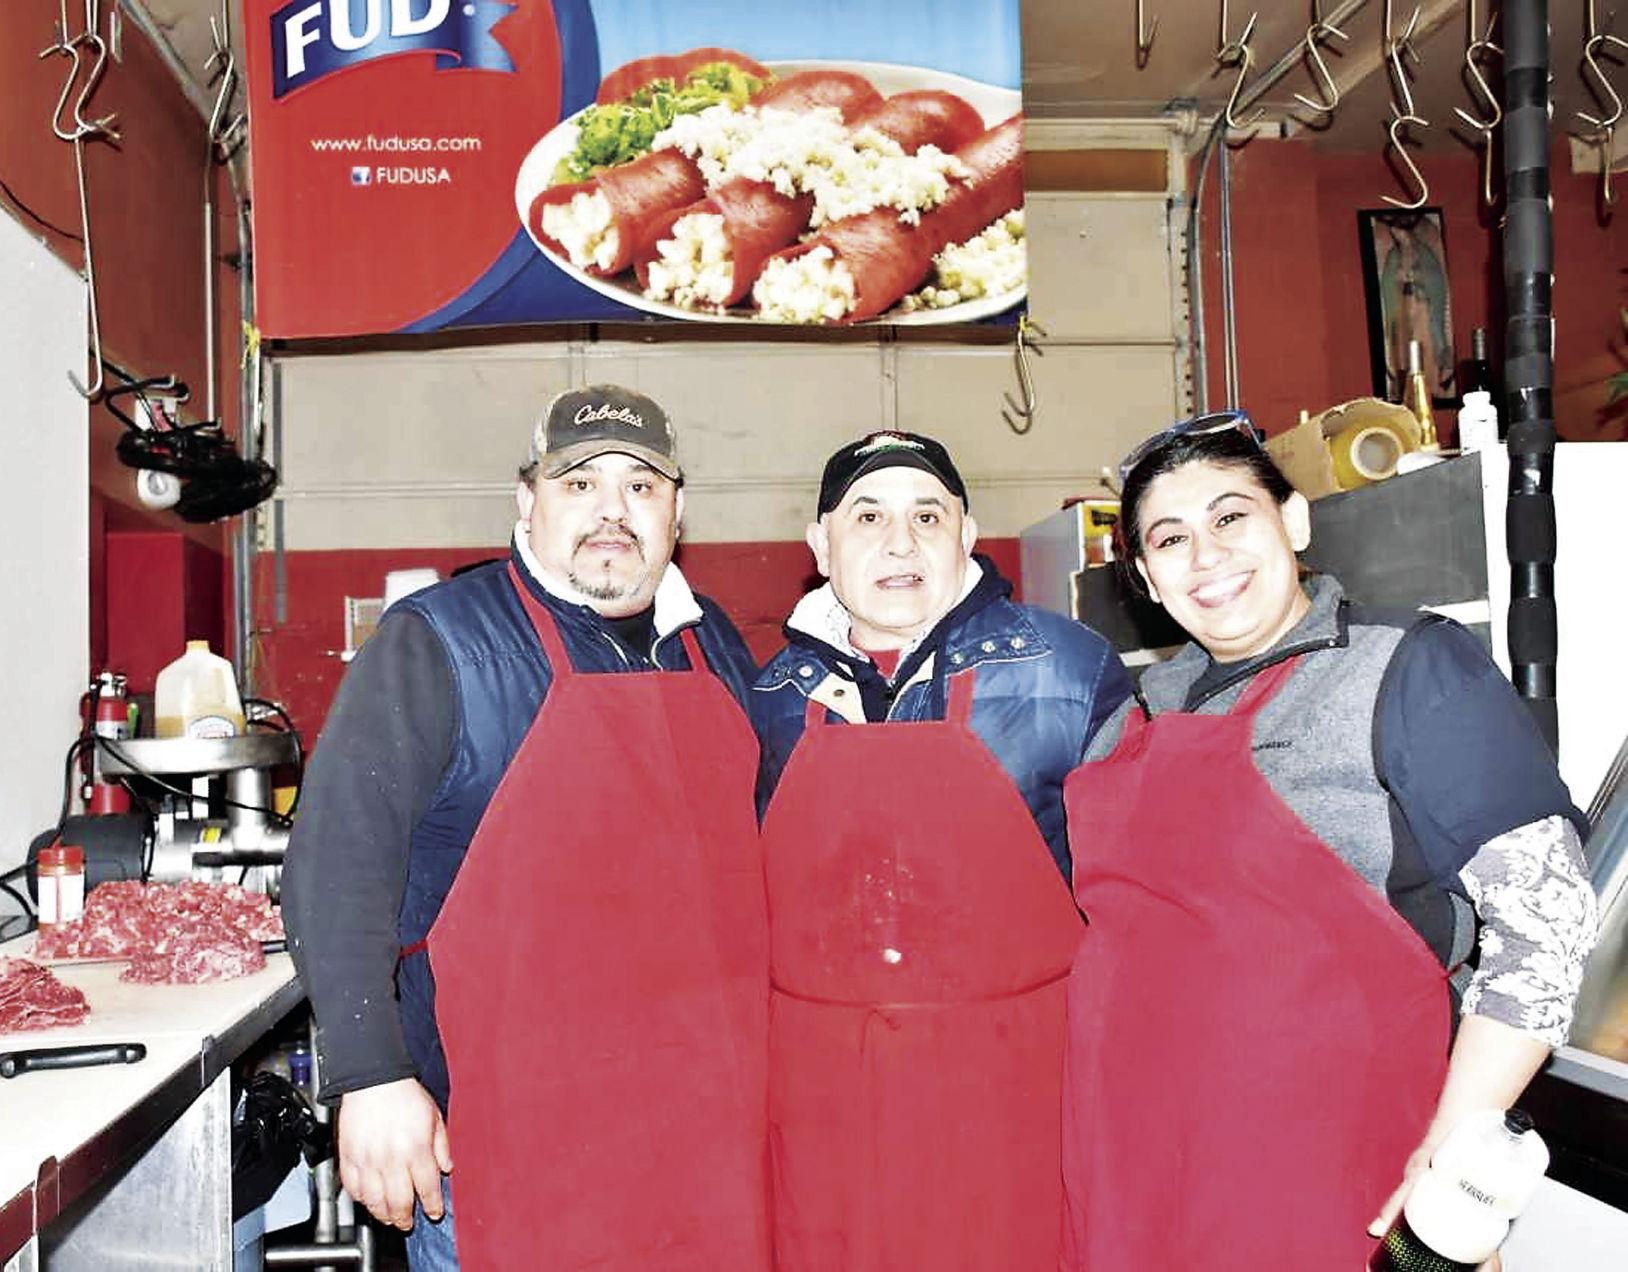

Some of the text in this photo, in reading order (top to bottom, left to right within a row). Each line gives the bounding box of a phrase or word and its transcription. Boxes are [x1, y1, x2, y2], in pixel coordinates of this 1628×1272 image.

[284, 0, 450, 78] FUD
[310, 134, 482, 151] www.fudusa.com
[376, 166, 451, 185] FUDUSA
[573, 403, 643, 428] Cabela's
